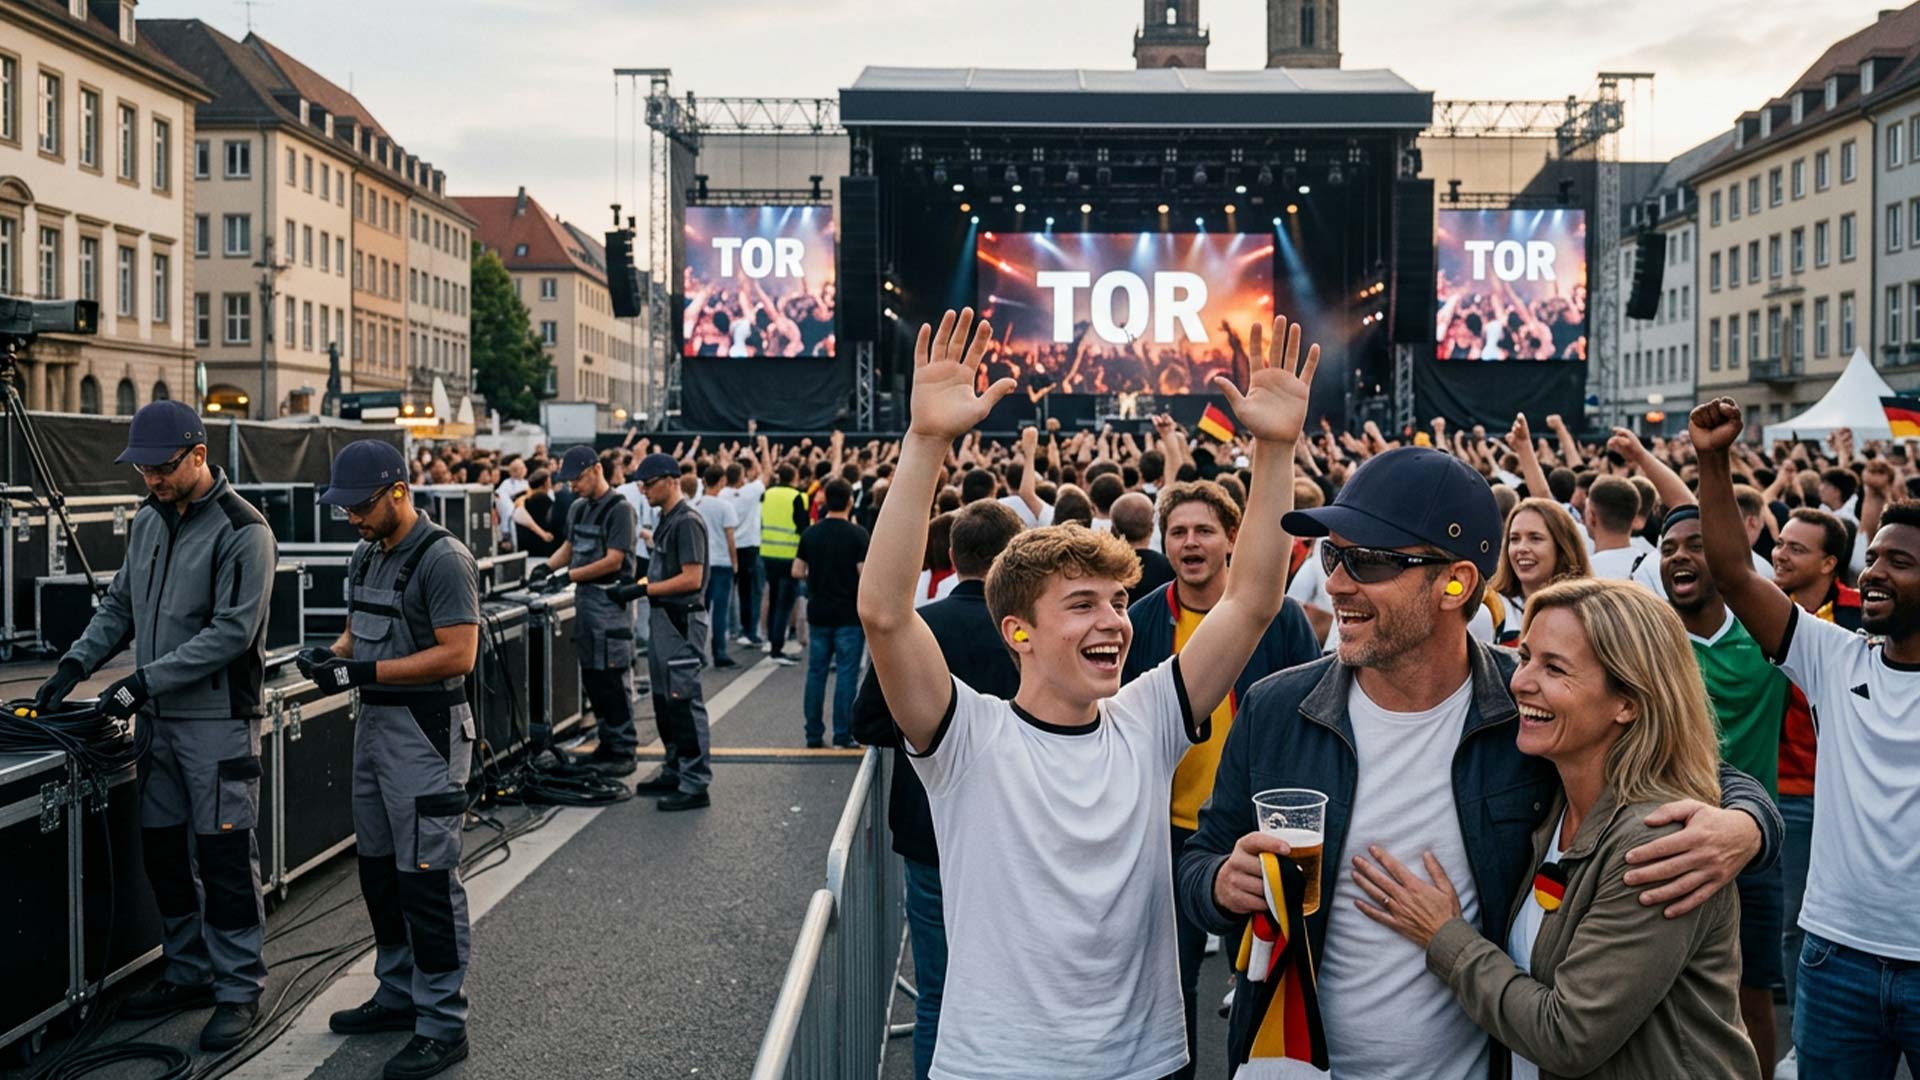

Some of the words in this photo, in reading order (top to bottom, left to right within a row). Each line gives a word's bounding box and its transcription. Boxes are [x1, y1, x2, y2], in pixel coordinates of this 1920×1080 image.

[711, 237, 805, 278] TOR
[1464, 240, 1557, 281] TOR
[1036, 270, 1209, 344] TOR
